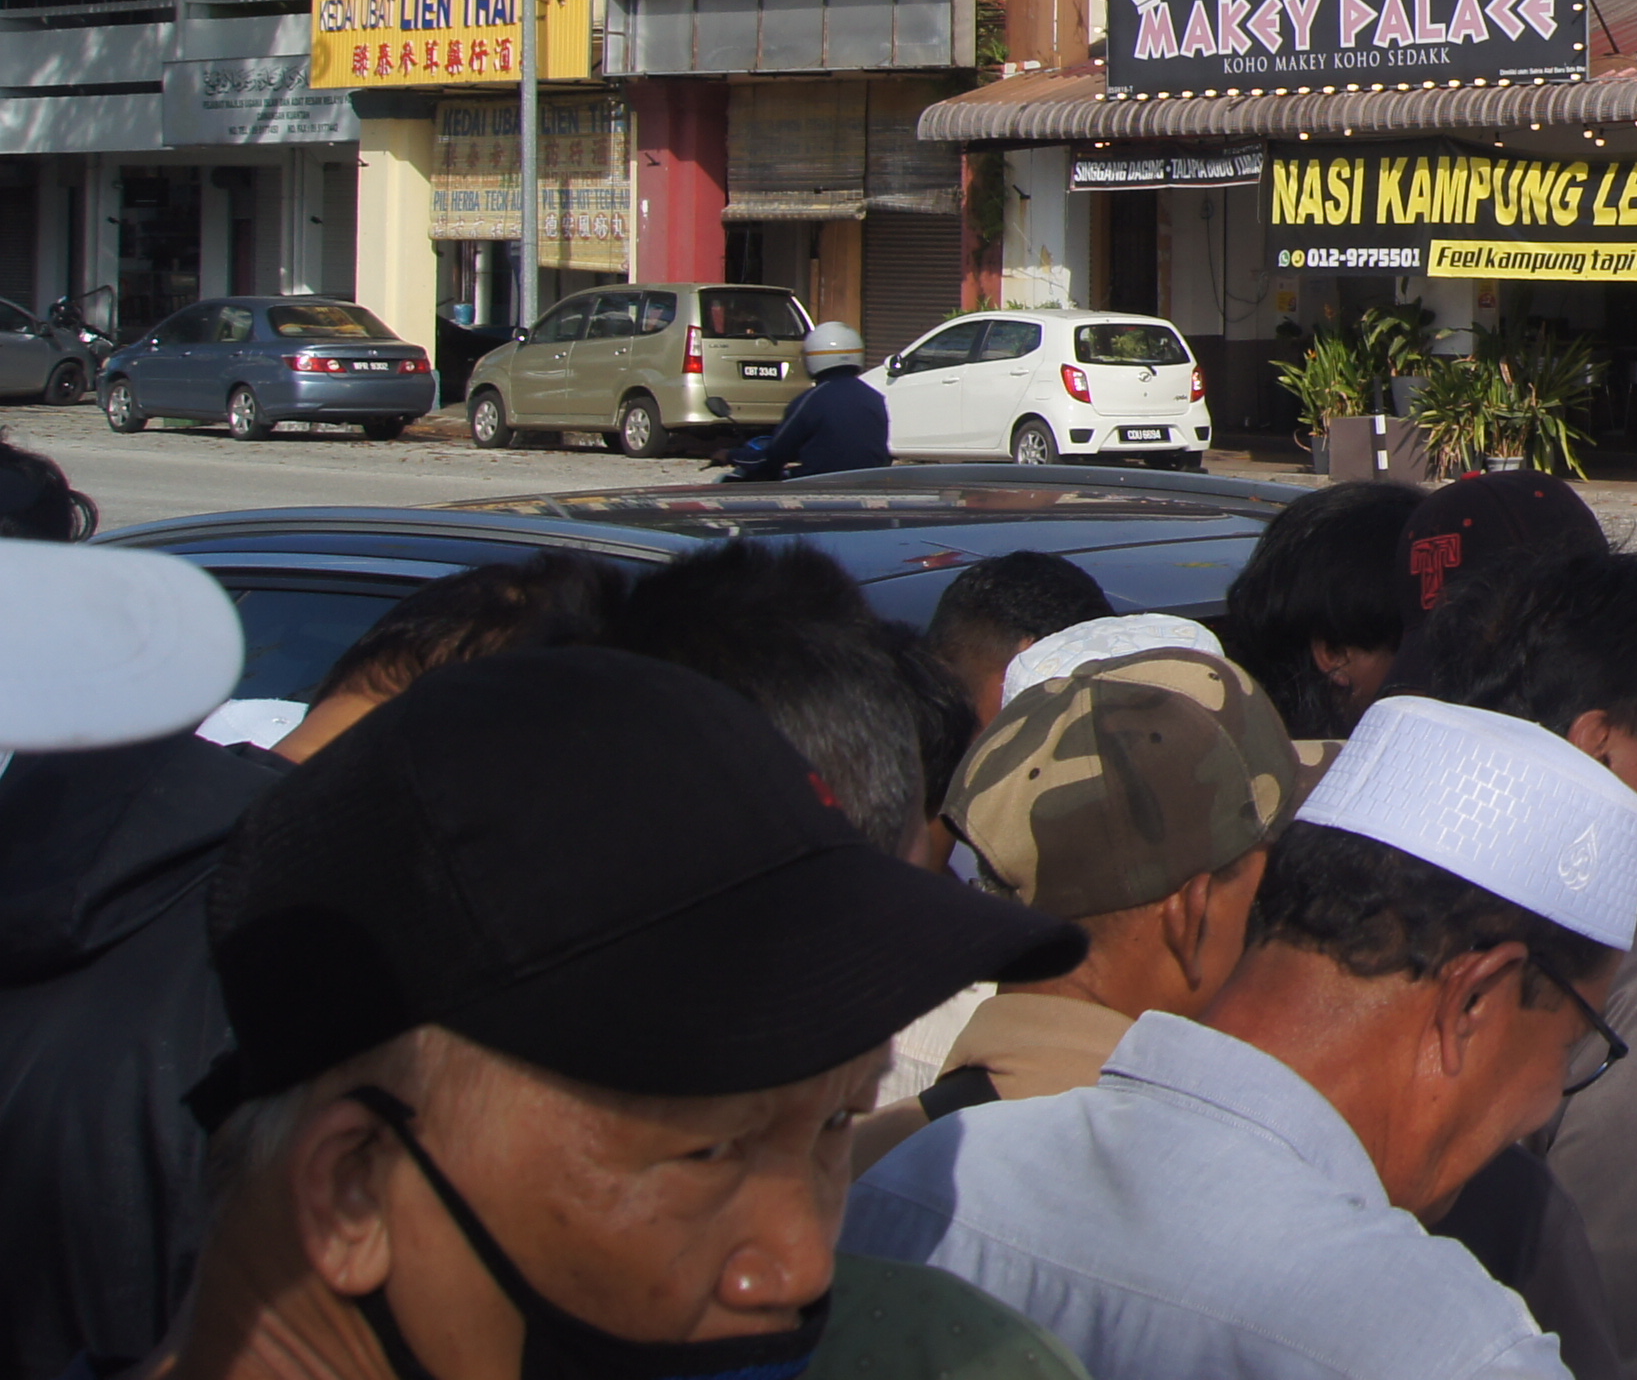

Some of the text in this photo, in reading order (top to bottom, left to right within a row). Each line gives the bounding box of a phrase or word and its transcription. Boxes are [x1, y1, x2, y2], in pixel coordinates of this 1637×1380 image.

[1223, 47, 1451, 74] KOHO MAKEY KOHO SEDAKK
[443, 108, 486, 136] KEDAI
[542, 106, 579, 135] LIEN
[1073, 161, 1127, 182] SINGGANG
[1127, 159, 1165, 181] DAGING
[434, 190, 448, 212] PIL
[451, 190, 480, 212] HERBA
[485, 190, 508, 211] TECK
[542, 189, 557, 210] PIL
[594, 189, 617, 210] TECK
[1271, 158, 1365, 225] NASI
[1375, 156, 1589, 226] KAMPUNG
[1307, 248, 1421, 268] 012-9775501
[1436, 246, 1483, 267] Feel
[1484, 247, 1586, 275] kampung
[1590, 249, 1637, 275] tapi
